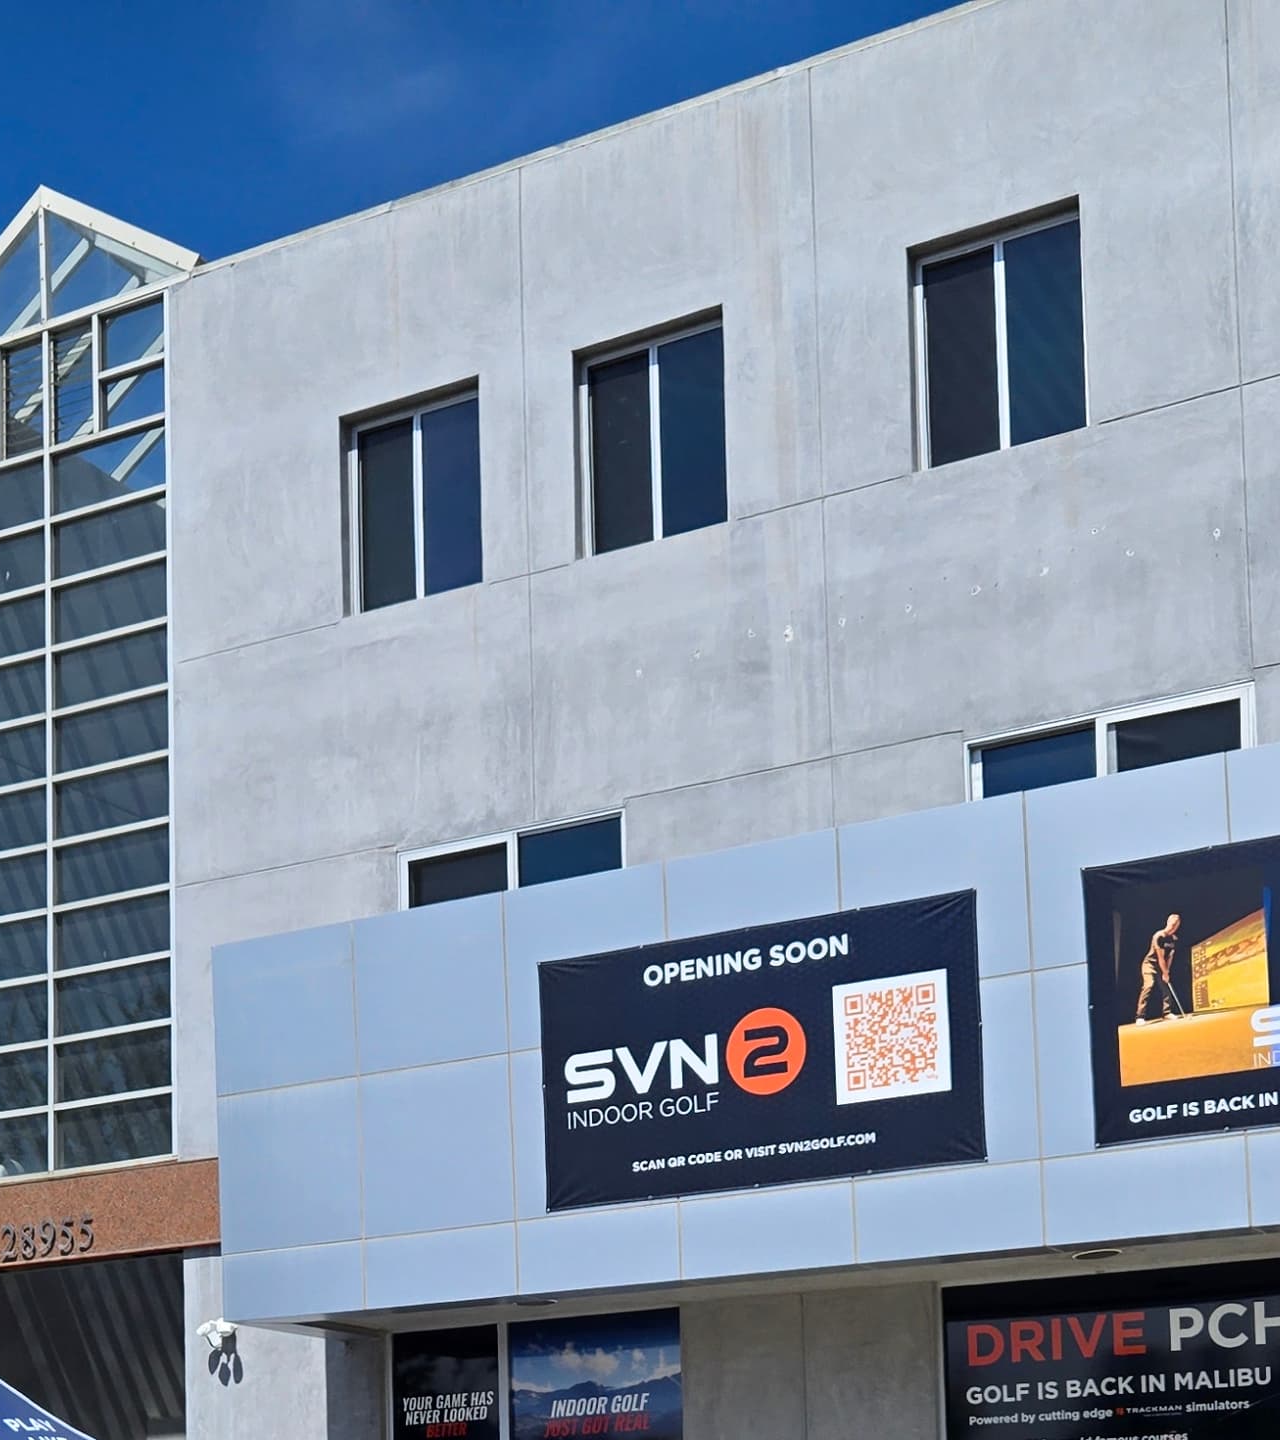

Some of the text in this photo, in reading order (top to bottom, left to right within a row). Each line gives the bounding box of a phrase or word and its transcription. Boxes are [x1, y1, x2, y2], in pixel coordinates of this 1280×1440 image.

[643, 933, 849, 987] OPENING SOON
[567, 1092, 720, 1130] INDOOR GOLF
[1129, 1103, 1178, 1123] GOLF
[1182, 1100, 1200, 1117] IS
[1204, 1094, 1255, 1116] BACK
[1259, 1091, 1279, 1107] IN
[632, 1132, 876, 1173] SCAN QR CODE OR VISIT SVN2GOLF.COM
[0, 1211, 94, 1262] 28955
[966, 1312, 1148, 1367] DRIVE
[966, 1366, 1272, 1405] GOLF IS BACK IN MALIBU
[402, 1390, 494, 1412] YOUR GAME HAS
[406, 1405, 488, 1426] NEVER LOOKED
[551, 1393, 650, 1419] INDOOR GOLF
[969, 1400, 1250, 1426] Powered by cutting edge TRACKMAN simulators
[2, 1417, 56, 1432] PLAY
[426, 1422, 467, 1439] BETTER
[544, 1411, 650, 1439] JUST GOT REAL
